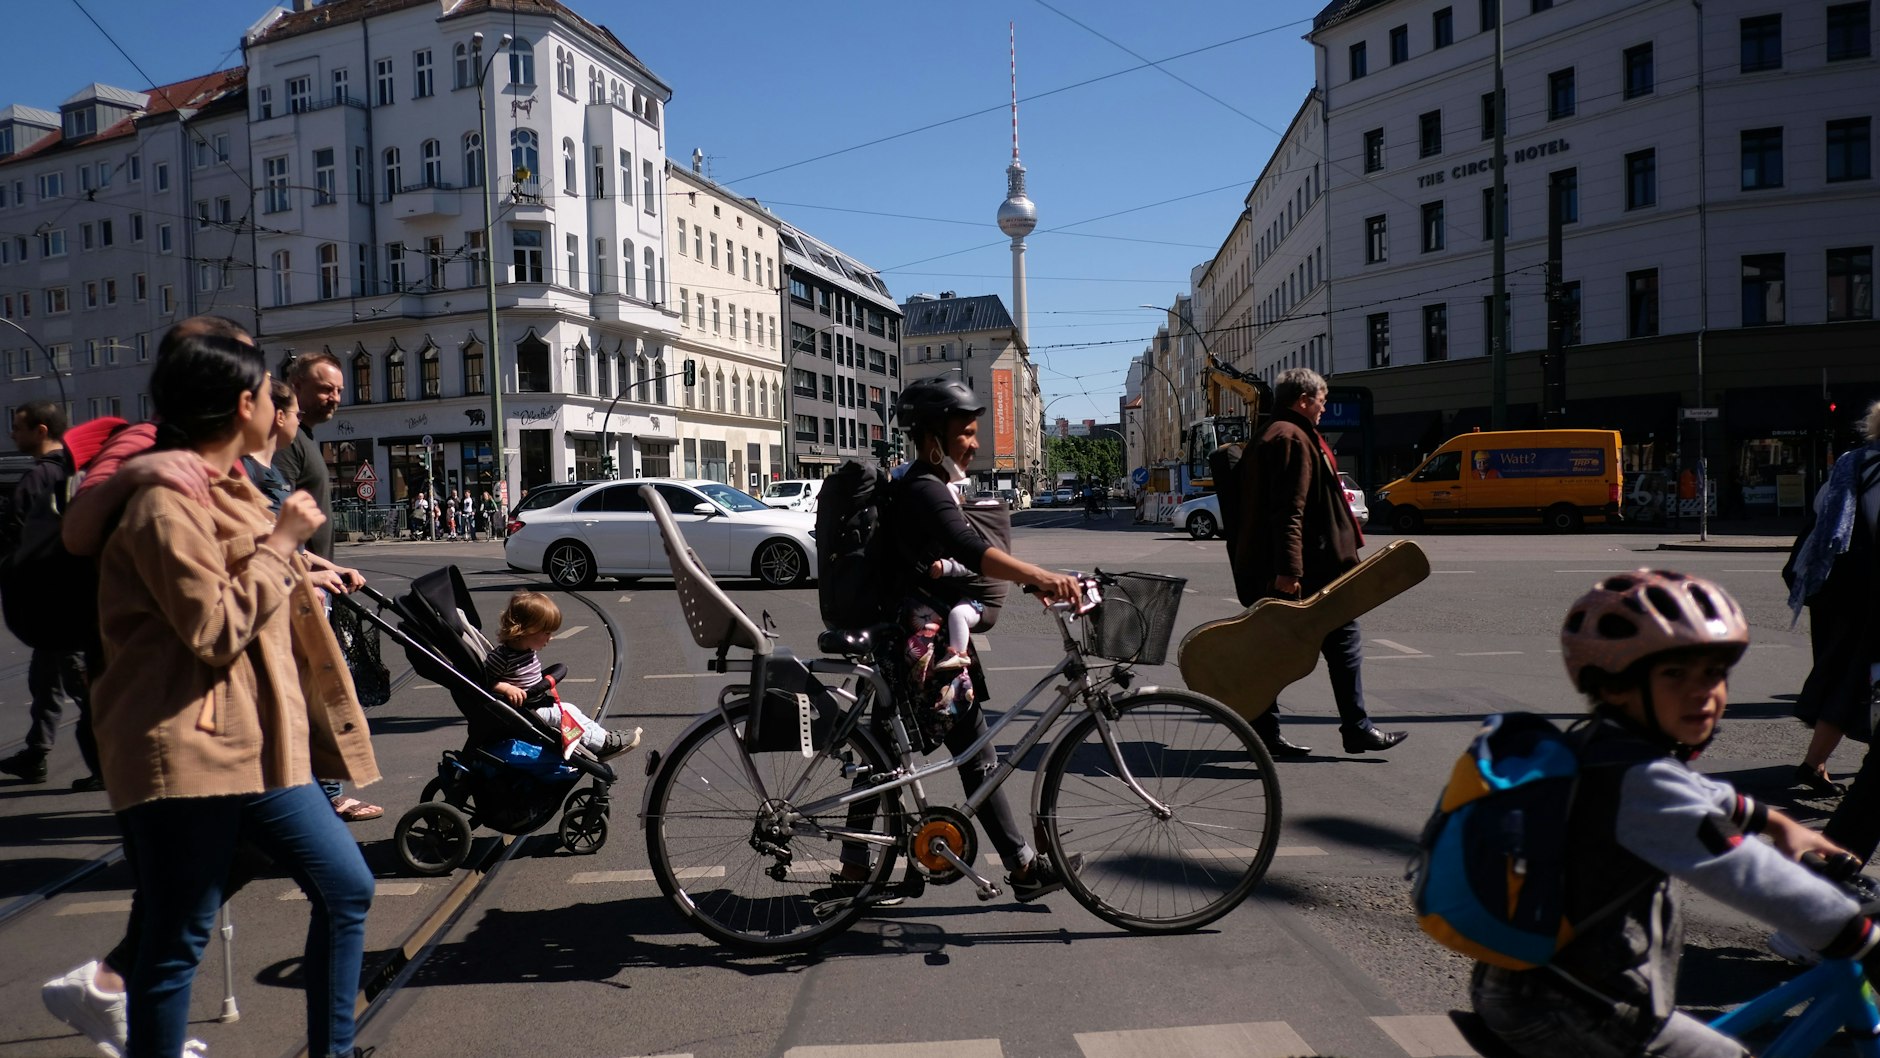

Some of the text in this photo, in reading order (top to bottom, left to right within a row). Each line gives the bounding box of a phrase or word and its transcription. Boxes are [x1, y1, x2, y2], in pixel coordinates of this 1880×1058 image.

[1417, 170, 1445, 188] THE
[1514, 138, 1570, 163] HOTEL
[1333, 403, 1342, 416] U
[1500, 452, 1537, 464] Watt?
[361, 487, 371, 495] 30
